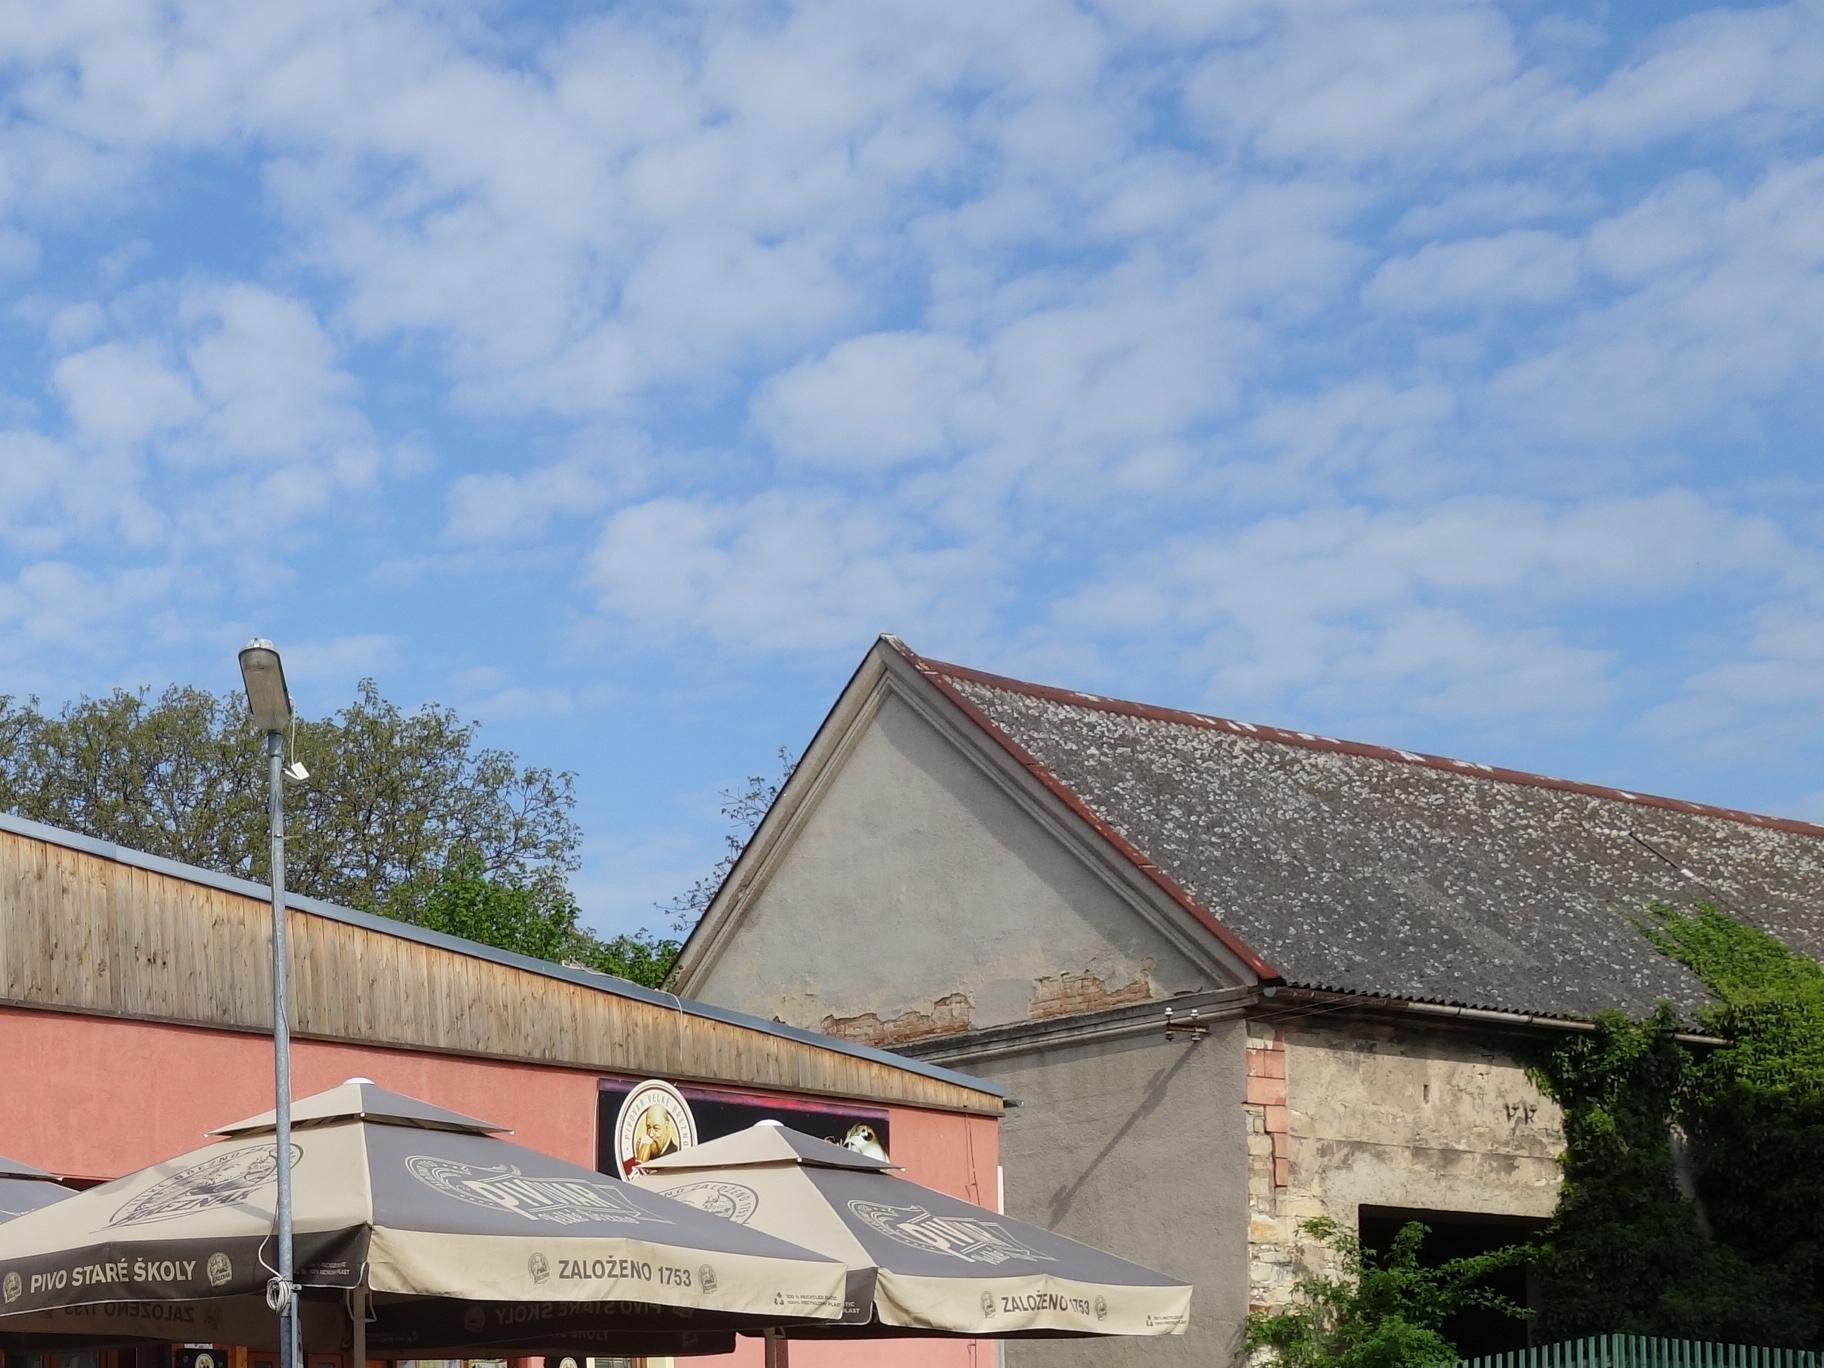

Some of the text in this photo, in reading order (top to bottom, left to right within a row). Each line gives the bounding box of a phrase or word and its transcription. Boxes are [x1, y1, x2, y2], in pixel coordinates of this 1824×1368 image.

[30, 1257, 196, 1293] PIVO STARÉ ŠKOLY
[558, 1255, 652, 1282] ZALOŽENO
[658, 1266, 691, 1288] 1753
[1001, 1289, 1090, 1317] ZALOŽENO 1753
